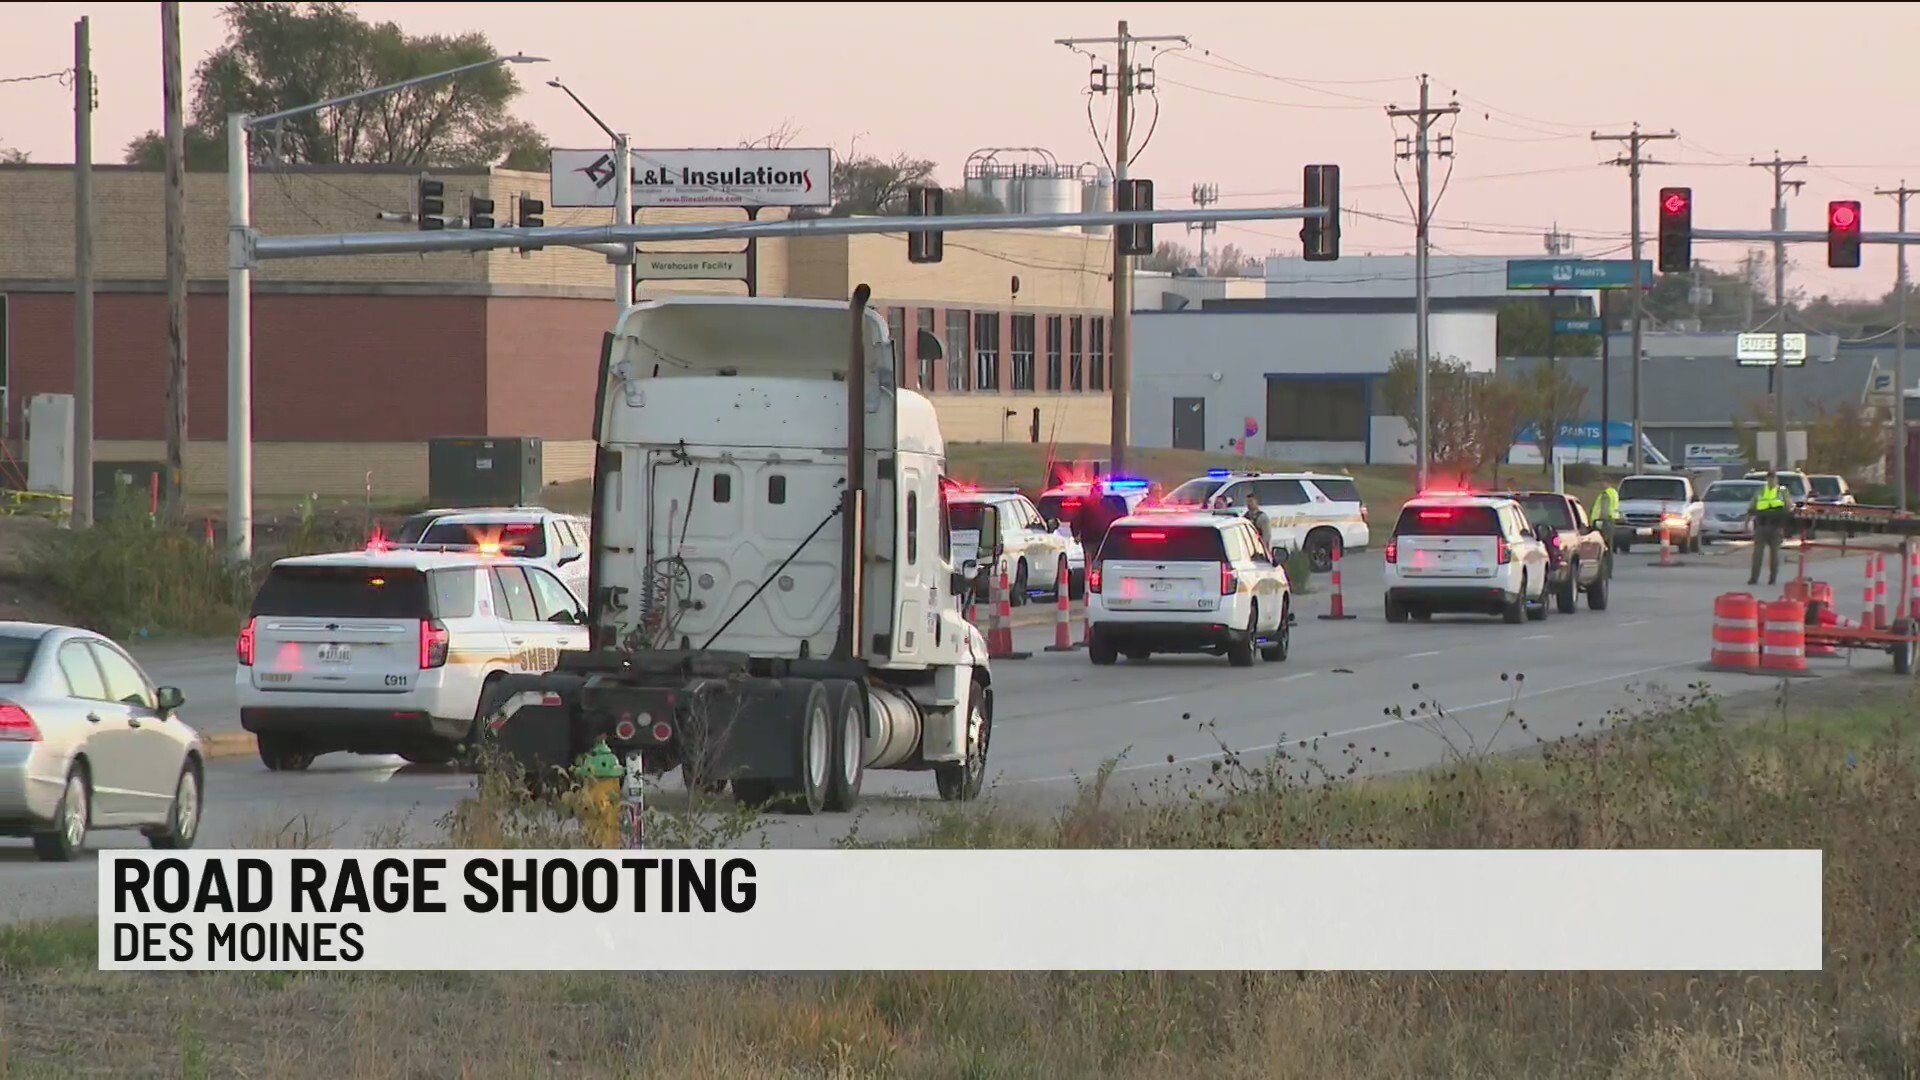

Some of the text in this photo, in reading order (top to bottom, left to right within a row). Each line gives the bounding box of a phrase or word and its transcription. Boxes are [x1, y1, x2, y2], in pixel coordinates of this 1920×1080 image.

[630, 166, 673, 186] L&L
[651, 260, 733, 272] Warehouse Facility
[1560, 425, 1601, 438] PAINTS
